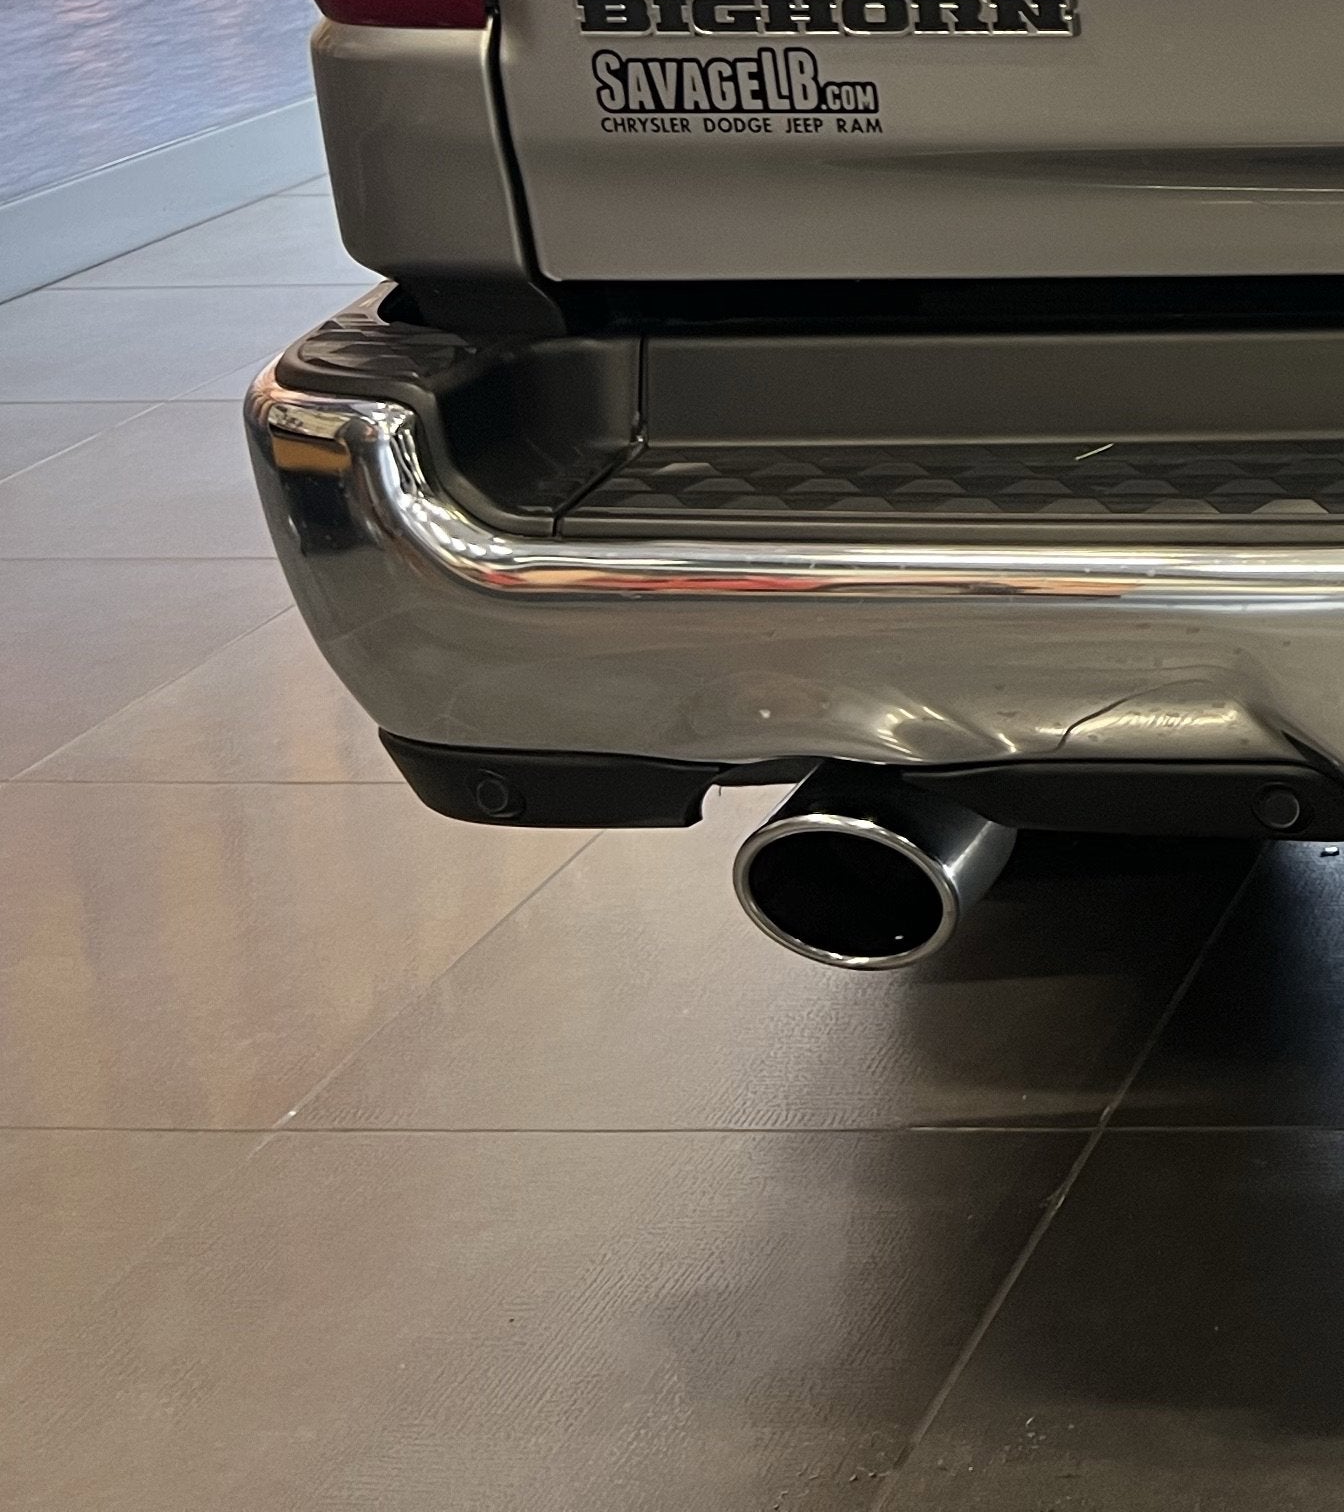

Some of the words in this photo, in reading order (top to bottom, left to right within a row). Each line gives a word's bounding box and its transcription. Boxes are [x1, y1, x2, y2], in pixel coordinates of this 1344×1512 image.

[601, 117, 692, 134] CHRYSLER
[703, 117, 773, 134] DODGE
[785, 117, 824, 134] JEEP
[836, 117, 883, 134] RAM
